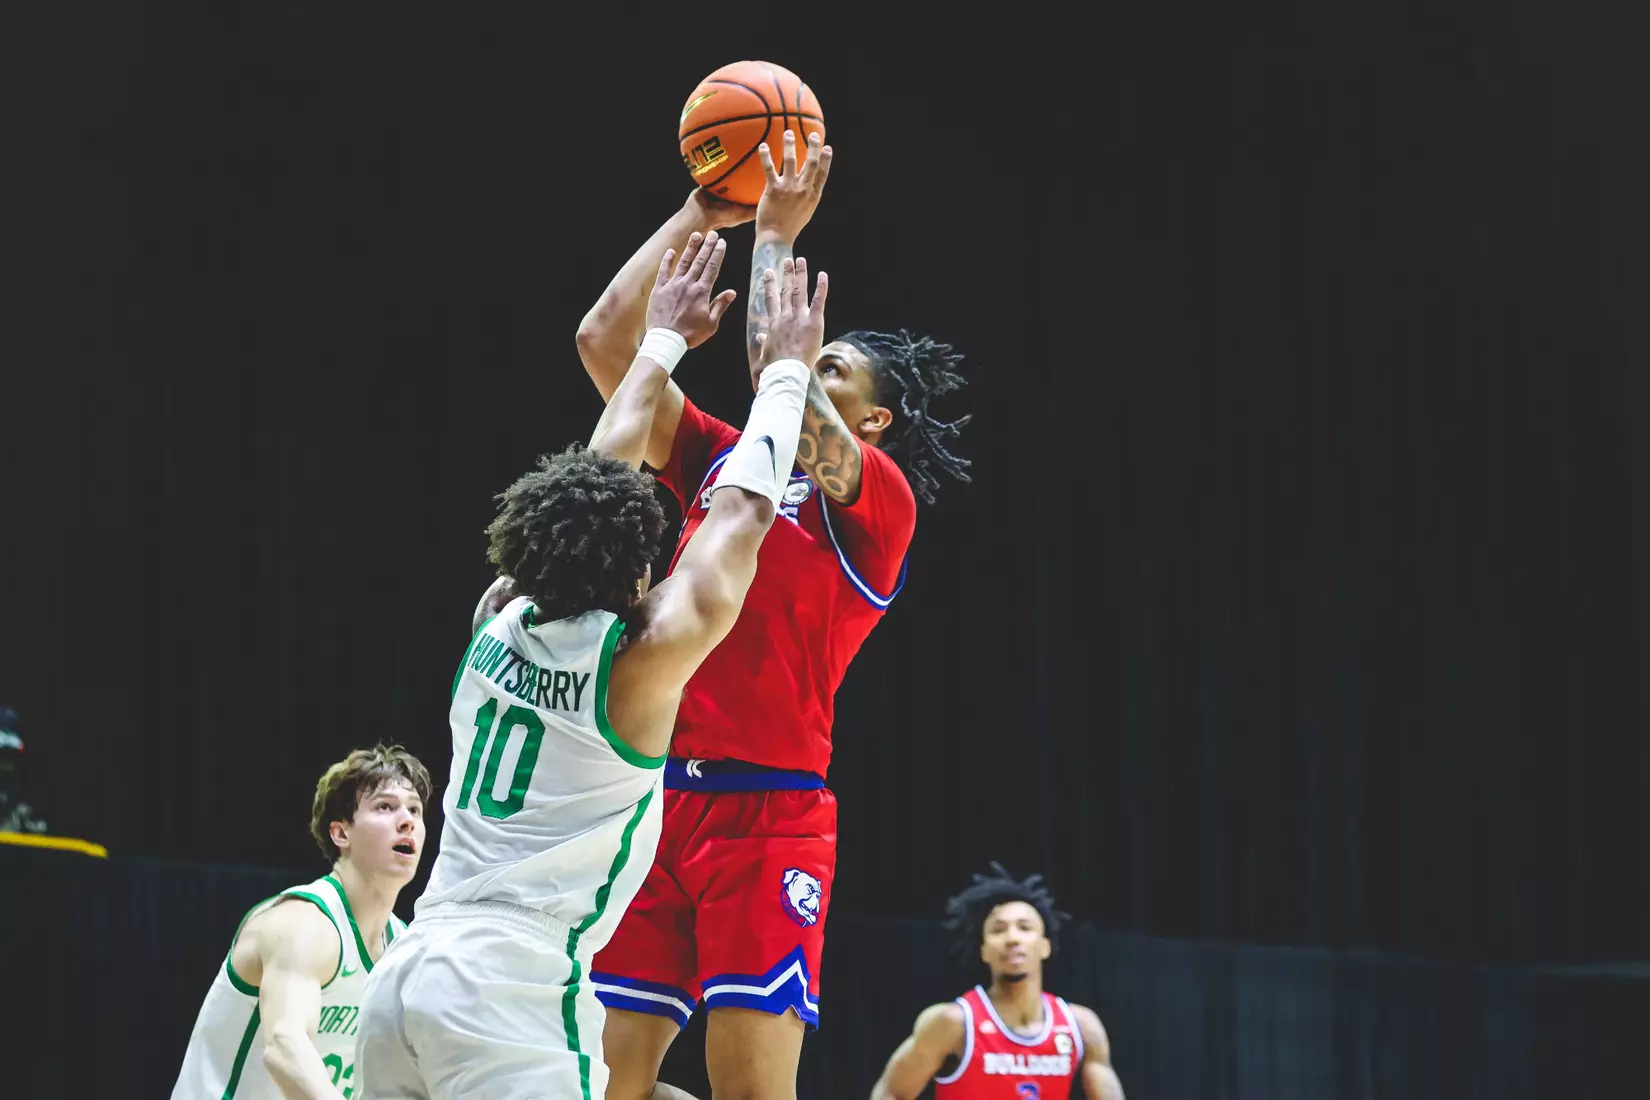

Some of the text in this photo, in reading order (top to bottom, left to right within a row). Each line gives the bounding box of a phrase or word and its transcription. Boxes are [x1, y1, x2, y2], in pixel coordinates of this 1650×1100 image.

[467, 633, 590, 712] HUNTSBERRY
[456, 697, 546, 820] 10
[317, 1005, 360, 1036] ORT
